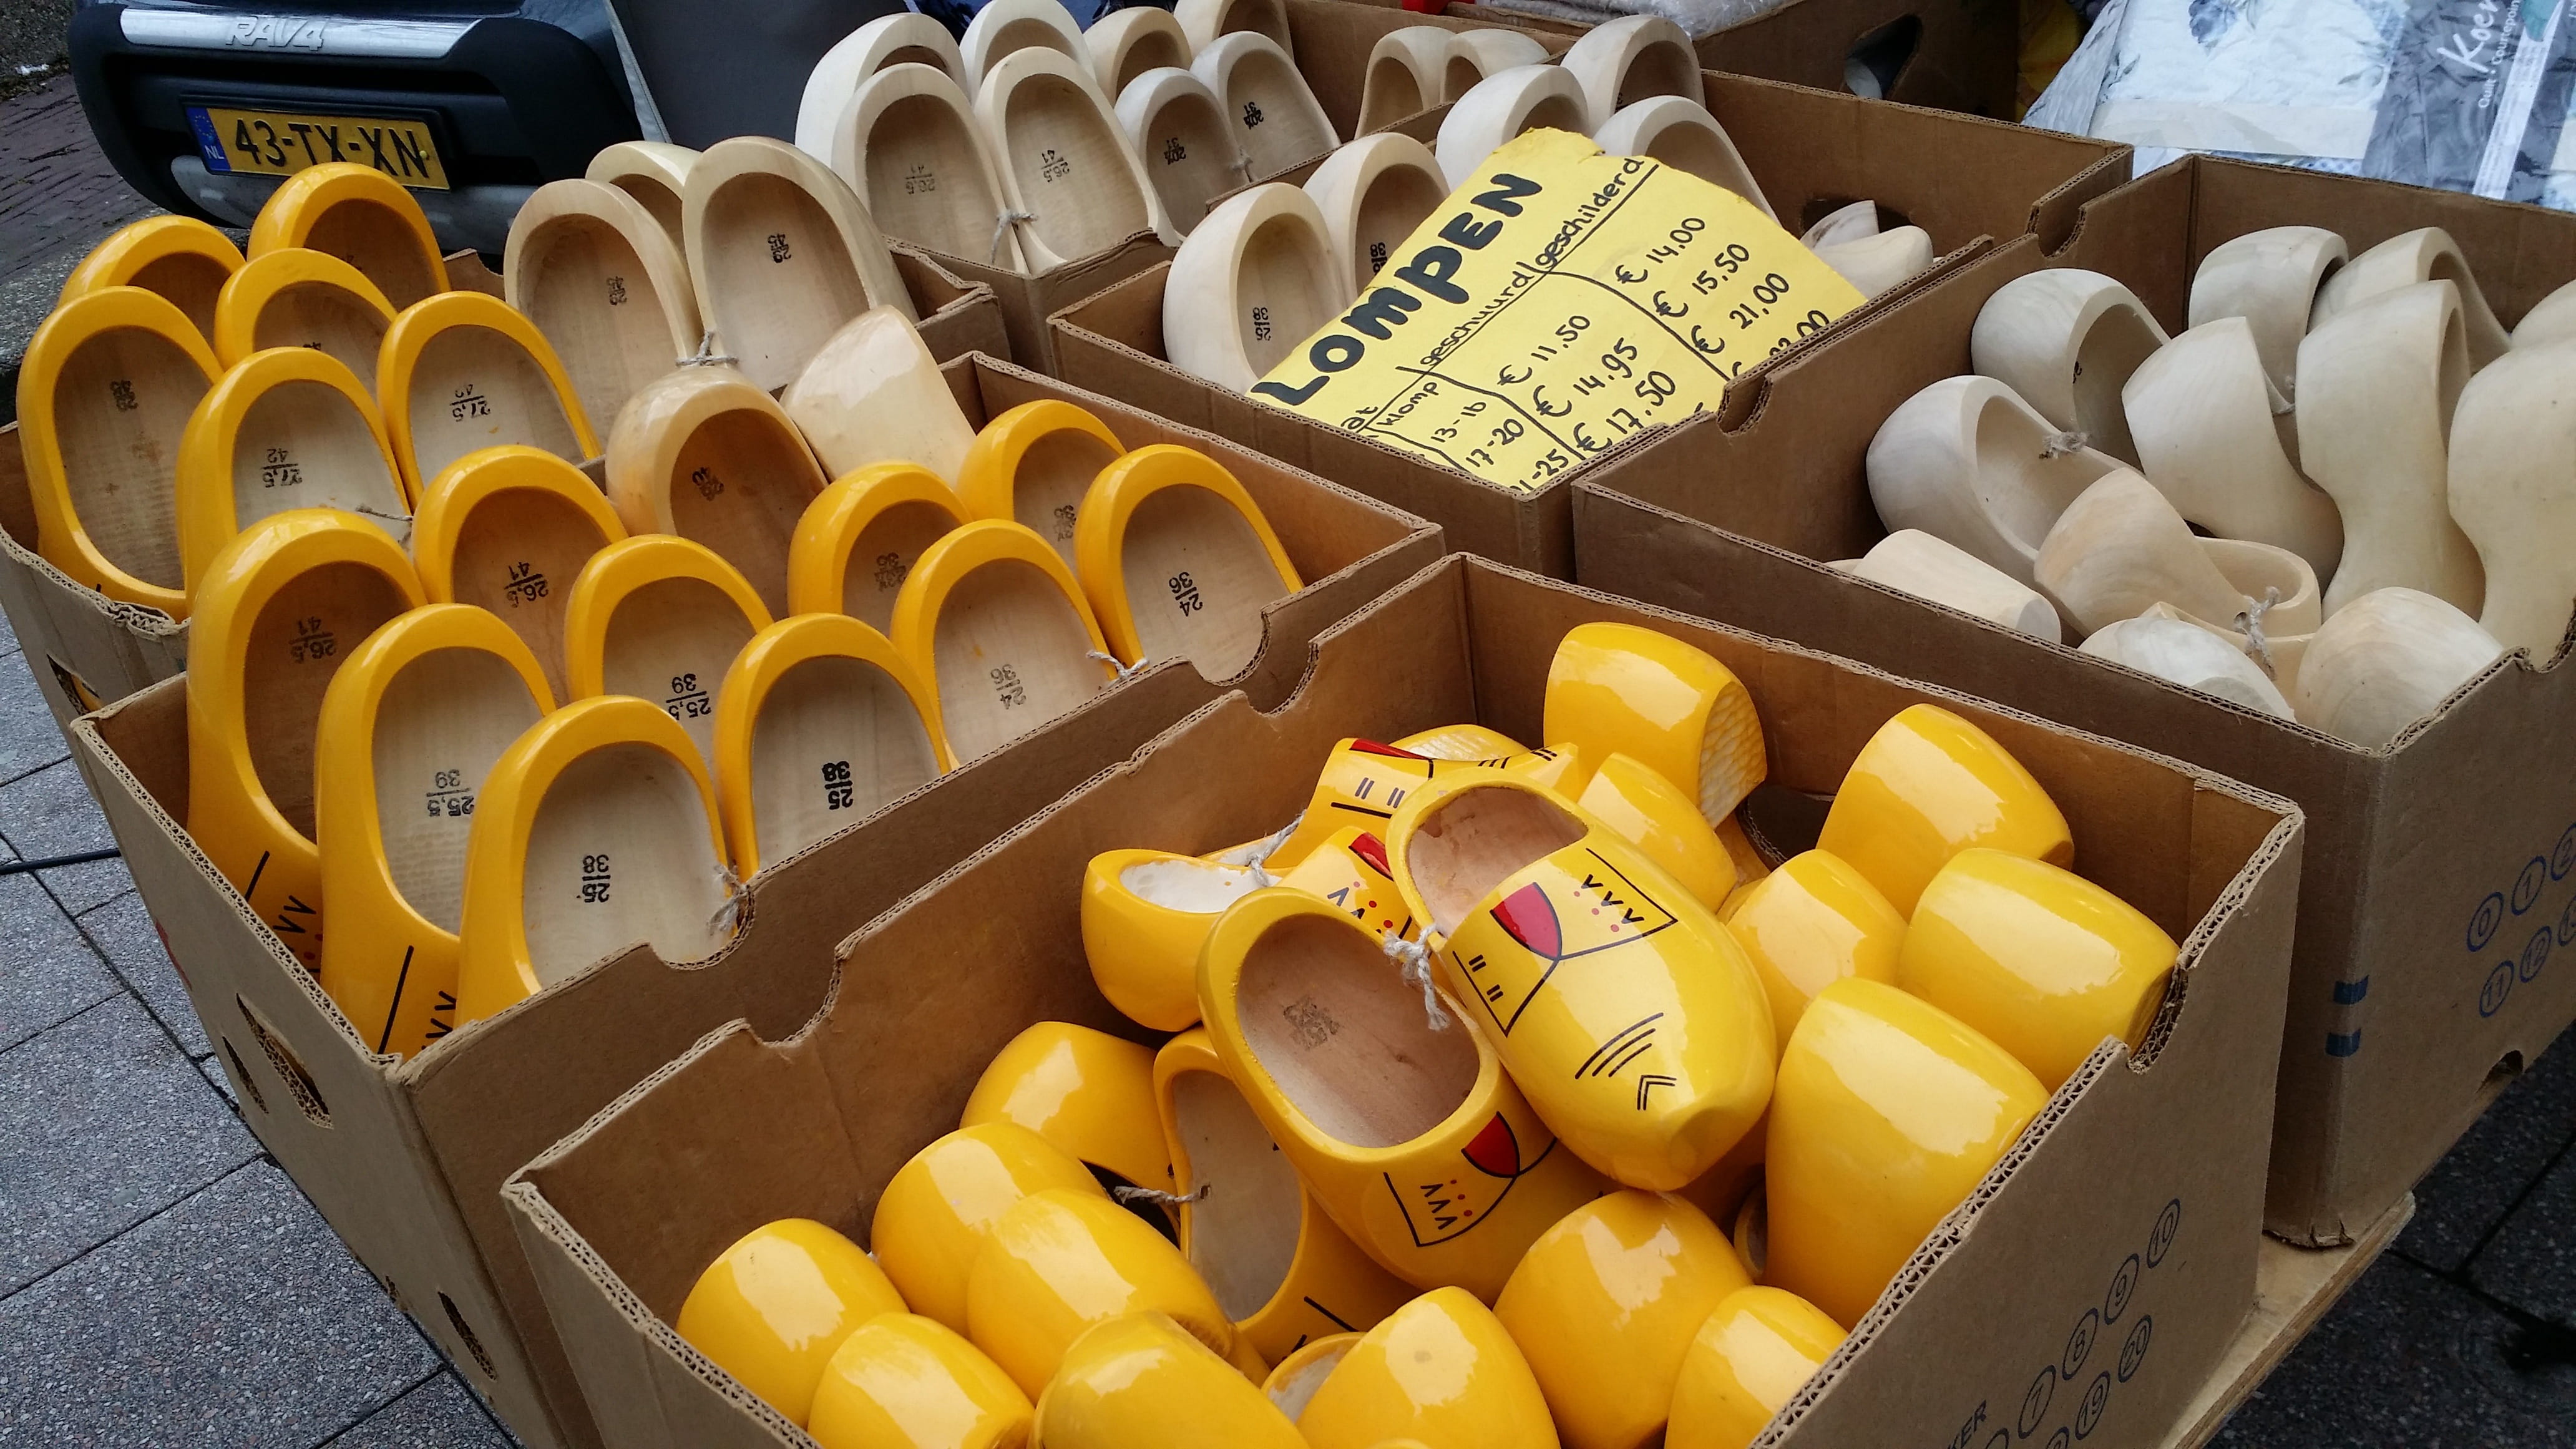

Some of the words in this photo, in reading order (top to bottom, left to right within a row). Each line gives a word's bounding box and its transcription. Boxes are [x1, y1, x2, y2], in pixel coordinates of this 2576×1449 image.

[226, 15, 329, 51] RAV4
[2478, 79, 2497, 108] Quilt
[205, 144, 225, 160] NL
[235, 118, 429, 178] 43-TX-XN
[1370, 242, 1385, 259] 38
[1420, 271, 1533, 366] geschuurd
[1535, 157, 1644, 266] geschilderd
[1252, 307, 1268, 323] 38
[1498, 365, 1533, 385] €
[1615, 265, 1648, 284] €
[1255, 324, 1271, 342] 25
[1466, 419, 1525, 467] 17-20
[1533, 385, 1572, 417] €
[1653, 290, 1689, 318] €
[1573, 422, 1612, 452] €
[1690, 325, 1725, 354] €
[1377, 382, 1438, 427] klomp
[266, 448, 289, 463] 42
[262, 468, 303, 488] 27,5
[507, 562, 530, 579] 41
[1168, 571, 1193, 595] 36
[1179, 593, 1203, 617] 24
[671, 673, 697, 693] 39
[990, 664, 1017, 684] 36
[668, 697, 713, 721] 25,5
[1000, 686, 1027, 710] 24
[435, 769, 461, 789] 39
[822, 761, 850, 781] 38
[827, 787, 854, 810] 25
[583, 854, 610, 874] 38
[583, 881, 610, 903] 25
